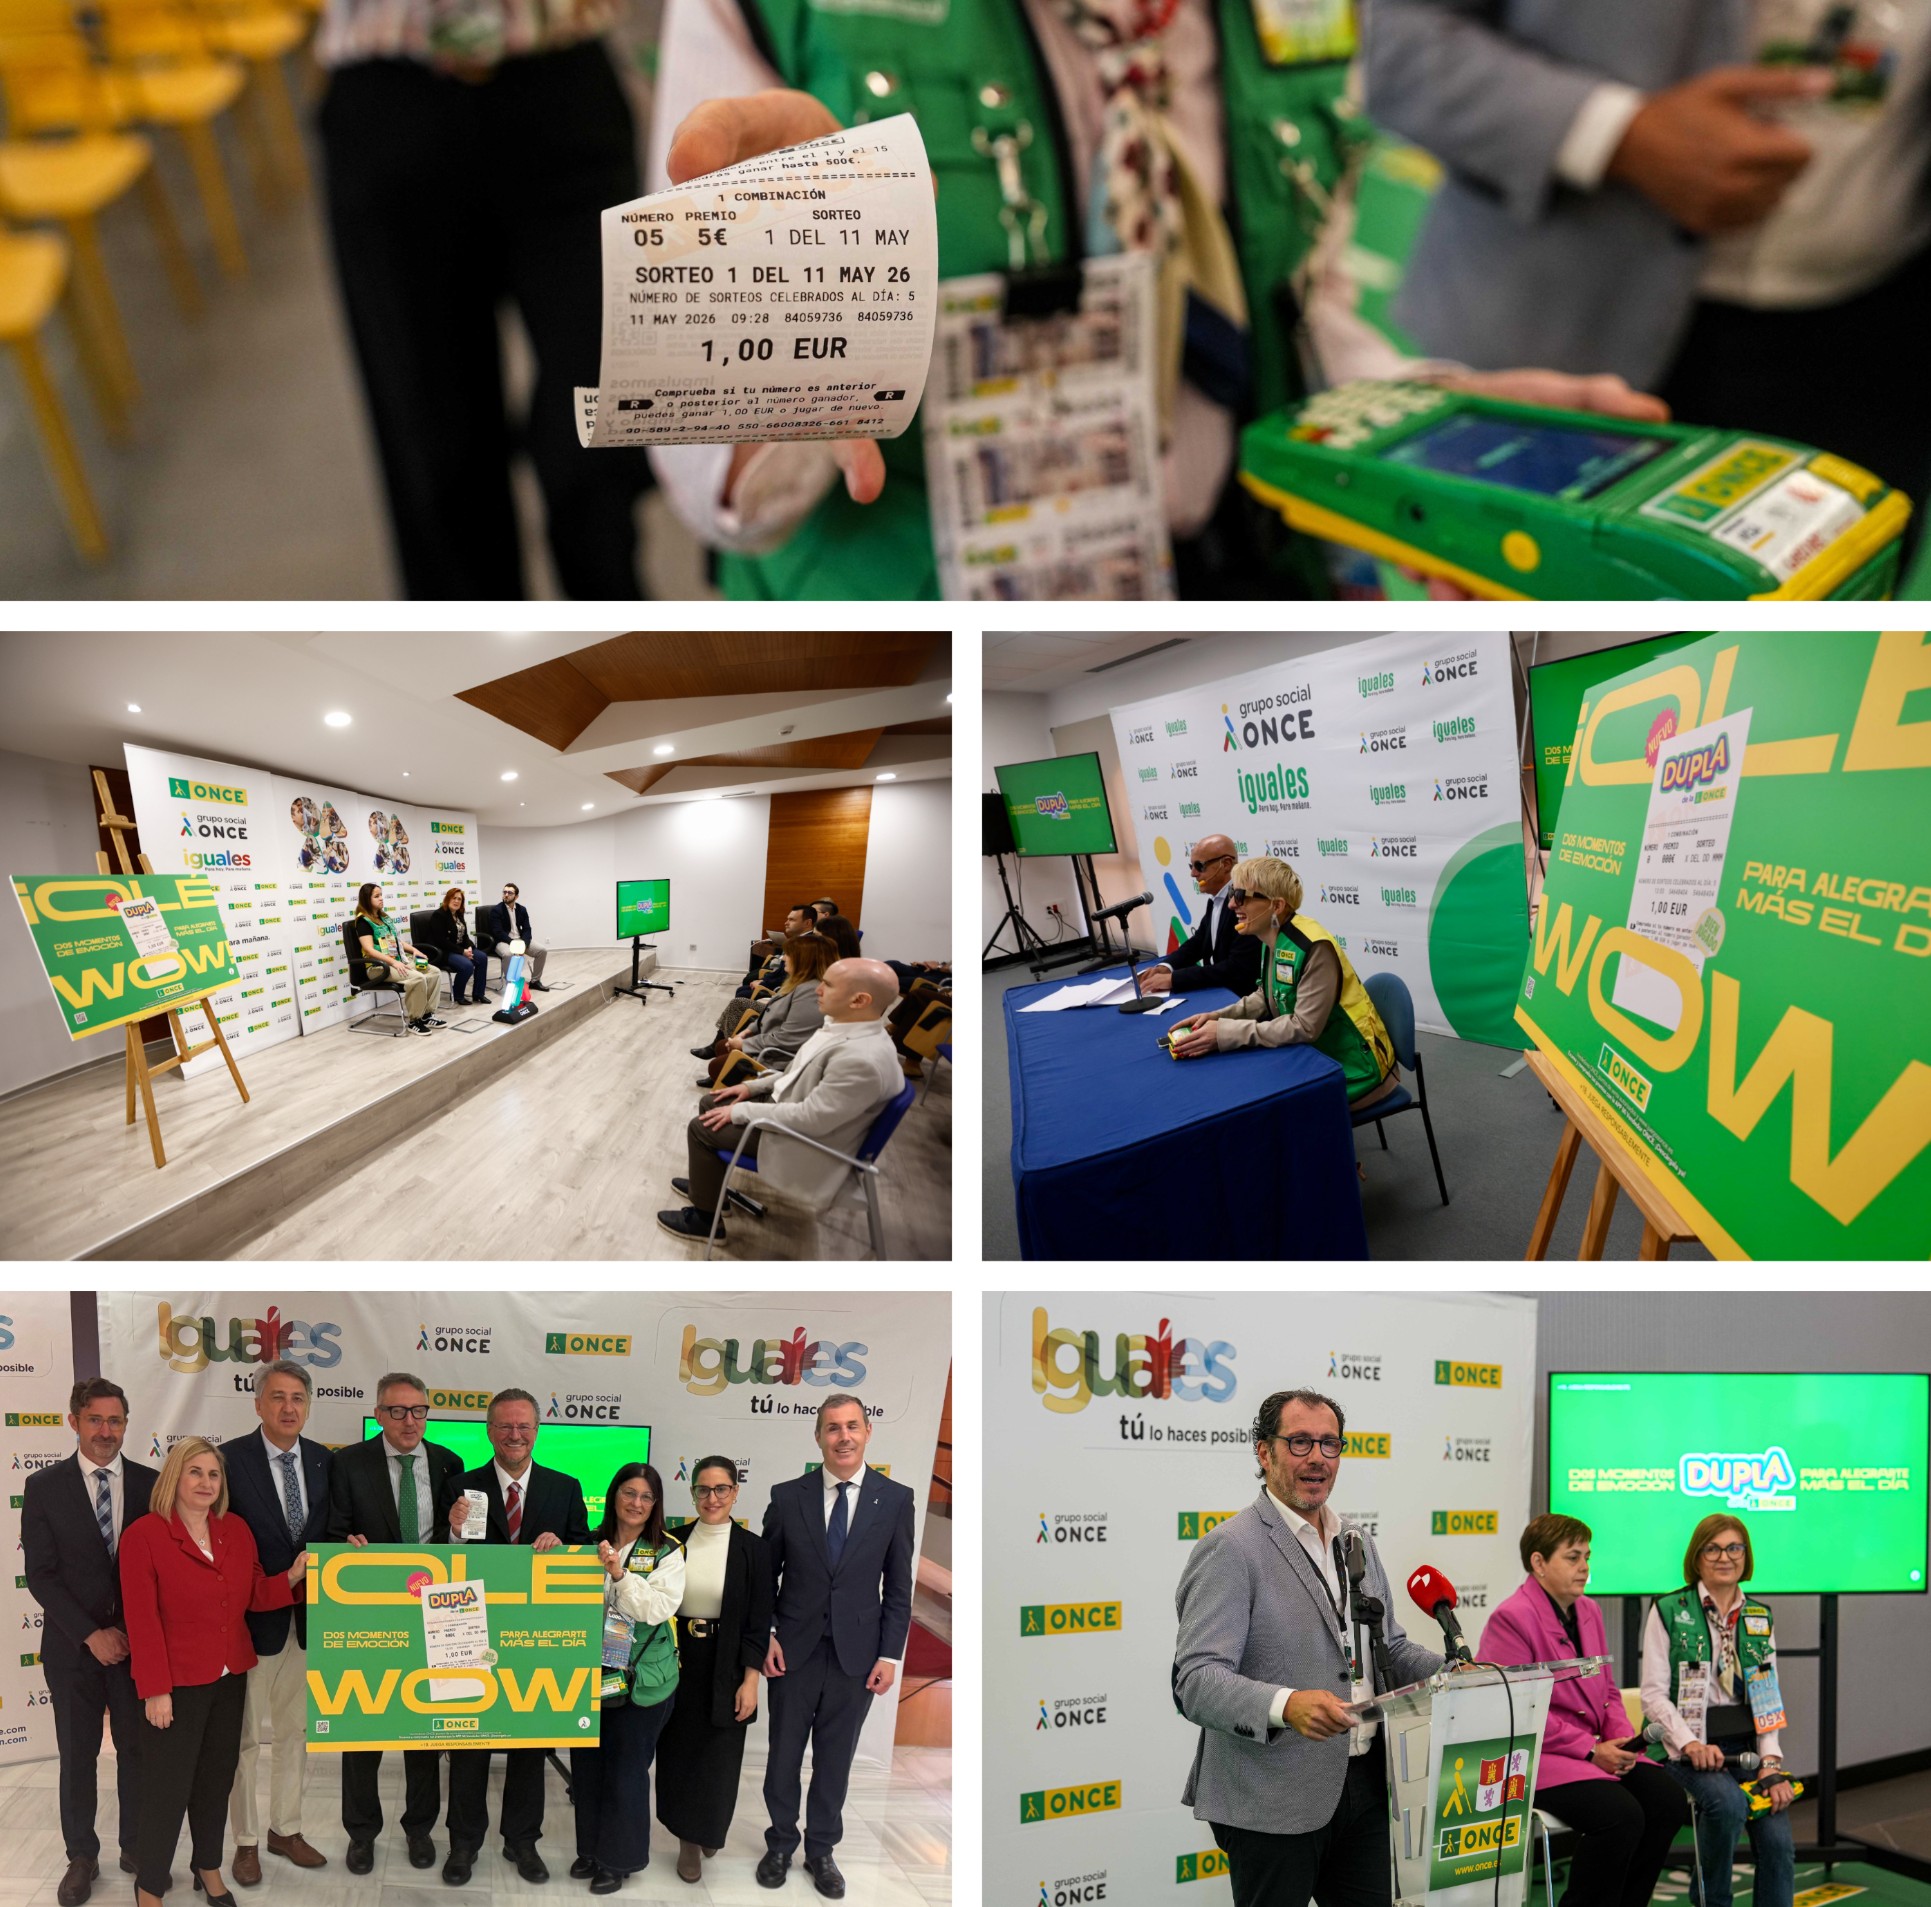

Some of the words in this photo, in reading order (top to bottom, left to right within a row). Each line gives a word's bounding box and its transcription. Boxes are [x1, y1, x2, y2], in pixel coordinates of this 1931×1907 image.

[759, 155, 795, 166] entre
[874, 145, 889, 153] 15
[738, 164, 774, 176] ganar
[782, 160, 819, 169] hasta
[826, 157, 861, 166] 500€.
[718, 193, 725, 202] 1
[734, 188, 826, 202] COMBINACIÓN
[621, 211, 674, 223] NÚMERO
[685, 210, 737, 222] PREMIO
[812, 209, 861, 220] SORTEO
[633, 228, 664, 246] 05
[698, 228, 728, 246] 5€
[765, 229, 774, 245] 1
[789, 229, 826, 246] DEL
[839, 229, 861, 245] 11
[875, 229, 910, 246] MAY
[635, 266, 714, 284] SORTEO
[728, 266, 737, 284] 1
[752, 266, 790, 283] DEL
[803, 266, 825, 283] 11
[839, 266, 876, 283] MAY
[887, 265, 911, 283] 26
[629, 290, 678, 304] NÚMERO
[685, 292, 702, 304] DE
[709, 292, 763, 303] SORTEOS
[770, 291, 844, 303] CELEBRADOS
[851, 291, 866, 302] AL
[872, 287, 901, 302] DÍA:
[908, 290, 915, 302] 5
[630, 314, 645, 326] 11
[653, 314, 678, 325] MAY
[685, 313, 716, 325] 2026
[731, 312, 770, 324] 09:28
[784, 312, 843, 324] 84059736
[857, 311, 914, 323] 84059736
[701, 338, 774, 368] 1,00
[794, 337, 847, 360] EUR
[654, 388, 717, 398] Comprueba
[723, 386, 736, 395] si
[743, 386, 756, 394] tu
[762, 384, 801, 394] número
[807, 384, 821, 393] es
[826, 381, 877, 392] anterior
[680, 398, 741, 409] posterior
[747, 395, 760, 405] al
[766, 393, 805, 405] número
[811, 393, 860, 405] ganador,
[634, 411, 675, 421] puedes
[681, 409, 714, 419] ganar
[754, 406, 774, 415] EUR
[792, 405, 825, 415] jugar
[831, 403, 843, 412] de
[849, 403, 884, 412] nuevo.
[1434, 658, 1457, 669] grupo
[1459, 649, 1478, 663] social
[1434, 661, 1478, 683] ONCE
[1358, 672, 1394, 698] iguales
[1240, 696, 1273, 718] grupo
[1276, 684, 1312, 706] social
[1243, 709, 1315, 748] ONCE
[1432, 716, 1475, 743] iguales
[1661, 734, 1729, 792] DUPLA
[1237, 763, 1310, 814] iguales
[1445, 778, 1465, 786] grupo
[1467, 774, 1488, 783] social
[194, 784, 244, 803] ONCE
[1446, 784, 1488, 800] ONCE
[1036, 792, 1068, 814] DUPLA
[197, 814, 223, 824] grupo
[224, 817, 247, 825] social
[441, 824, 464, 834] ONCE
[198, 824, 248, 840] ONCE
[442, 846, 465, 855] ONCE
[1382, 845, 1417, 857] ONCE
[1562, 833, 1577, 847] DOS
[1578, 836, 1627, 857] MOMENTOS
[183, 848, 251, 869] iguales
[434, 860, 466, 872] iguales
[1559, 849, 1573, 862] DE
[1572, 854, 1622, 876] EMOCIÓN
[1743, 861, 1806, 893] PARA
[1381, 887, 1416, 906] iguales
[124, 901, 155, 918] DUPLA
[1735, 888, 1814, 926] MÁS
[1818, 907, 1882, 946] EL
[242, 935, 270, 944] mañana.
[50, 940, 236, 1010] WOW!
[1612, 1061, 1646, 1103] ONCE
[158, 1301, 342, 1373] Iguales
[435, 1326, 463, 1336] grupo
[466, 1326, 492, 1336] social
[434, 1337, 490, 1354] ONCE
[570, 1337, 627, 1353] ONCE
[679, 1324, 869, 1396] Iguales
[1032, 1306, 1237, 1414] Iguales
[1455, 1366, 1499, 1385] ONCE
[317, 1386, 364, 1398] posible
[565, 1404, 620, 1420] ONCE
[751, 1394, 773, 1413] tú
[777, 1403, 789, 1414] lo
[22, 1415, 60, 1425] ONCE
[1120, 1413, 1144, 1440] tú
[1150, 1425, 1163, 1441] lo
[1168, 1426, 1207, 1442] haces
[1211, 1428, 1257, 1445] posibl
[1568, 1468, 1596, 1480] DOS
[1597, 1468, 1676, 1480] MOMENTOS
[1684, 1451, 1791, 1495] DUPLA
[1800, 1468, 1838, 1479] PARA
[1840, 1468, 1910, 1480] ALEGRARTE
[1568, 1480, 1595, 1492] DE
[1847, 1480, 1875, 1491] EL
[1055, 1514, 1081, 1524] grupo
[1083, 1512, 1108, 1522] social
[1055, 1526, 1107, 1543] ONCE
[306, 1545, 604, 1605] ¡OLÉ
[409, 1575, 431, 1594] NUEVO
[429, 1587, 477, 1609] DUPLA
[1050, 1606, 1117, 1630] ONCE
[346, 1638, 410, 1648] EMOCIÓN
[347, 1632, 410, 1640] MOMENTOS
[500, 1631, 530, 1639] PARA
[532, 1630, 587, 1639] ALEGRARTE
[500, 1638, 535, 1647] MÁS
[538, 1639, 559, 1647] EL
[562, 1638, 587, 1647] DÍA
[306, 1668, 601, 1715] WOW!
[446, 1720, 476, 1728] ONCE
[1054, 1707, 1107, 1729] ONCE
[1050, 1785, 1117, 1815] ONCE
[1464, 1822, 1516, 1850] ONCE
